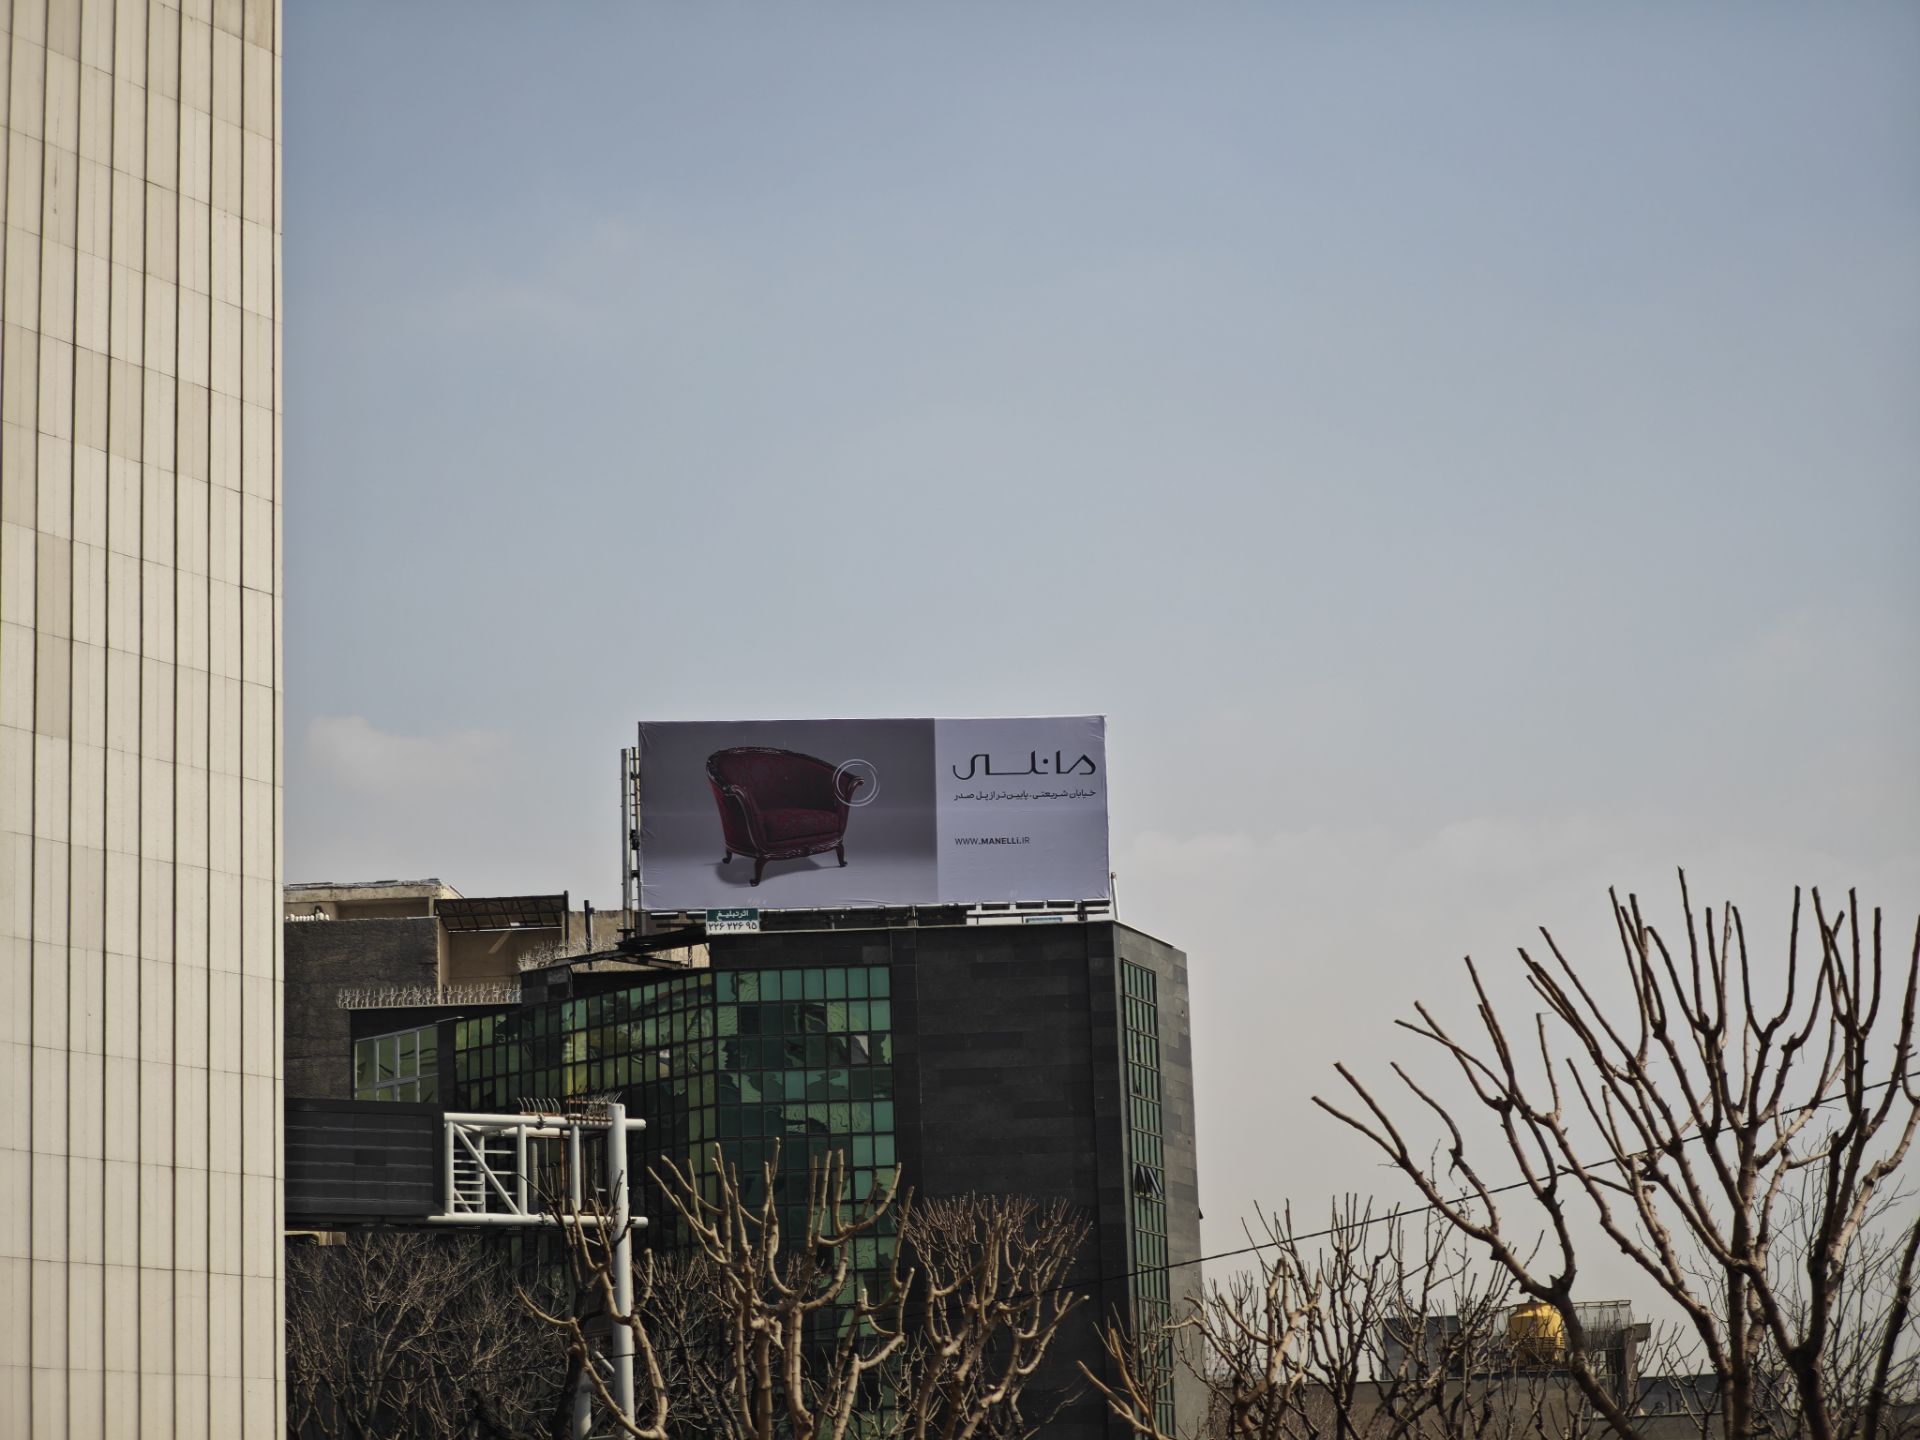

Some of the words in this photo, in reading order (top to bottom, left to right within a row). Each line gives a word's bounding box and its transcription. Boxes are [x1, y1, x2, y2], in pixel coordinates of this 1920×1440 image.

[953, 750, 1096, 780] مانلی
[953, 792, 975, 802] صدر
[976, 791, 989, 801] پل
[1069, 789, 1096, 799] خیابان
